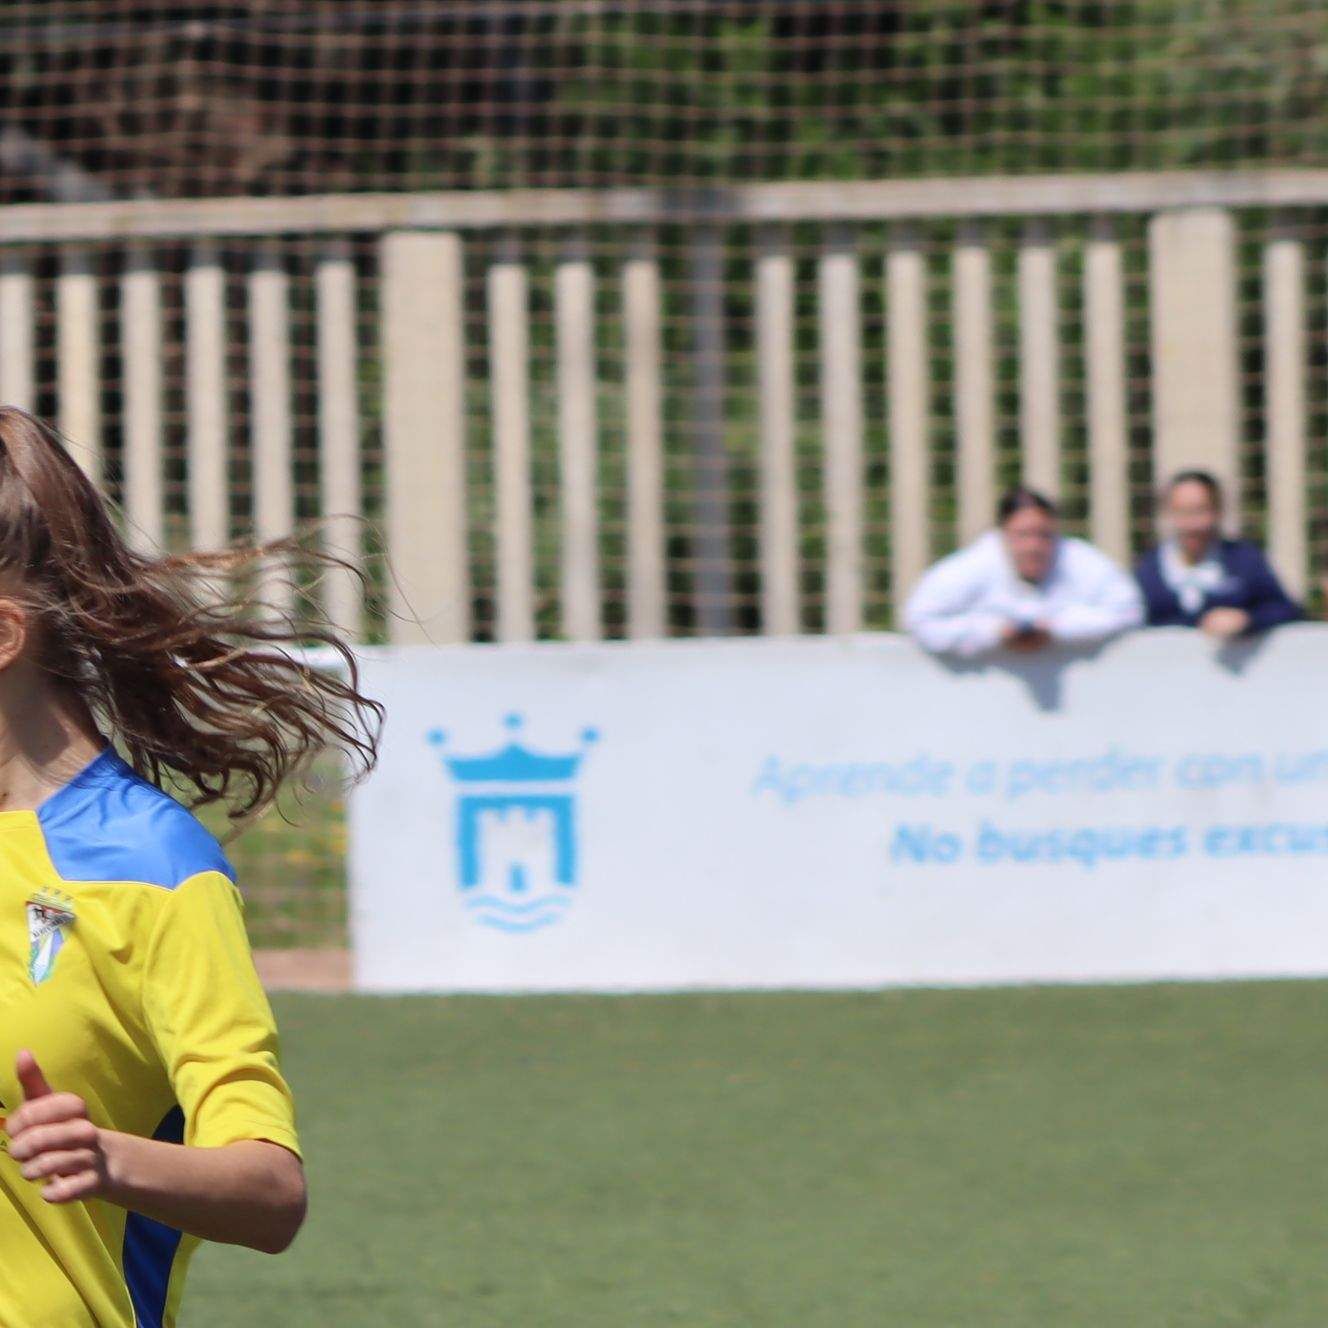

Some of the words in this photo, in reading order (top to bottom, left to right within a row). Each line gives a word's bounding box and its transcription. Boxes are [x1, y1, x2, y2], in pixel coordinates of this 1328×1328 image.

[750, 751, 956, 807] Aprende
[966, 757, 998, 797] a
[1006, 741, 1164, 804] perder
[1175, 751, 1262, 791] con
[890, 821, 963, 865] No
[975, 815, 1187, 871] busques
